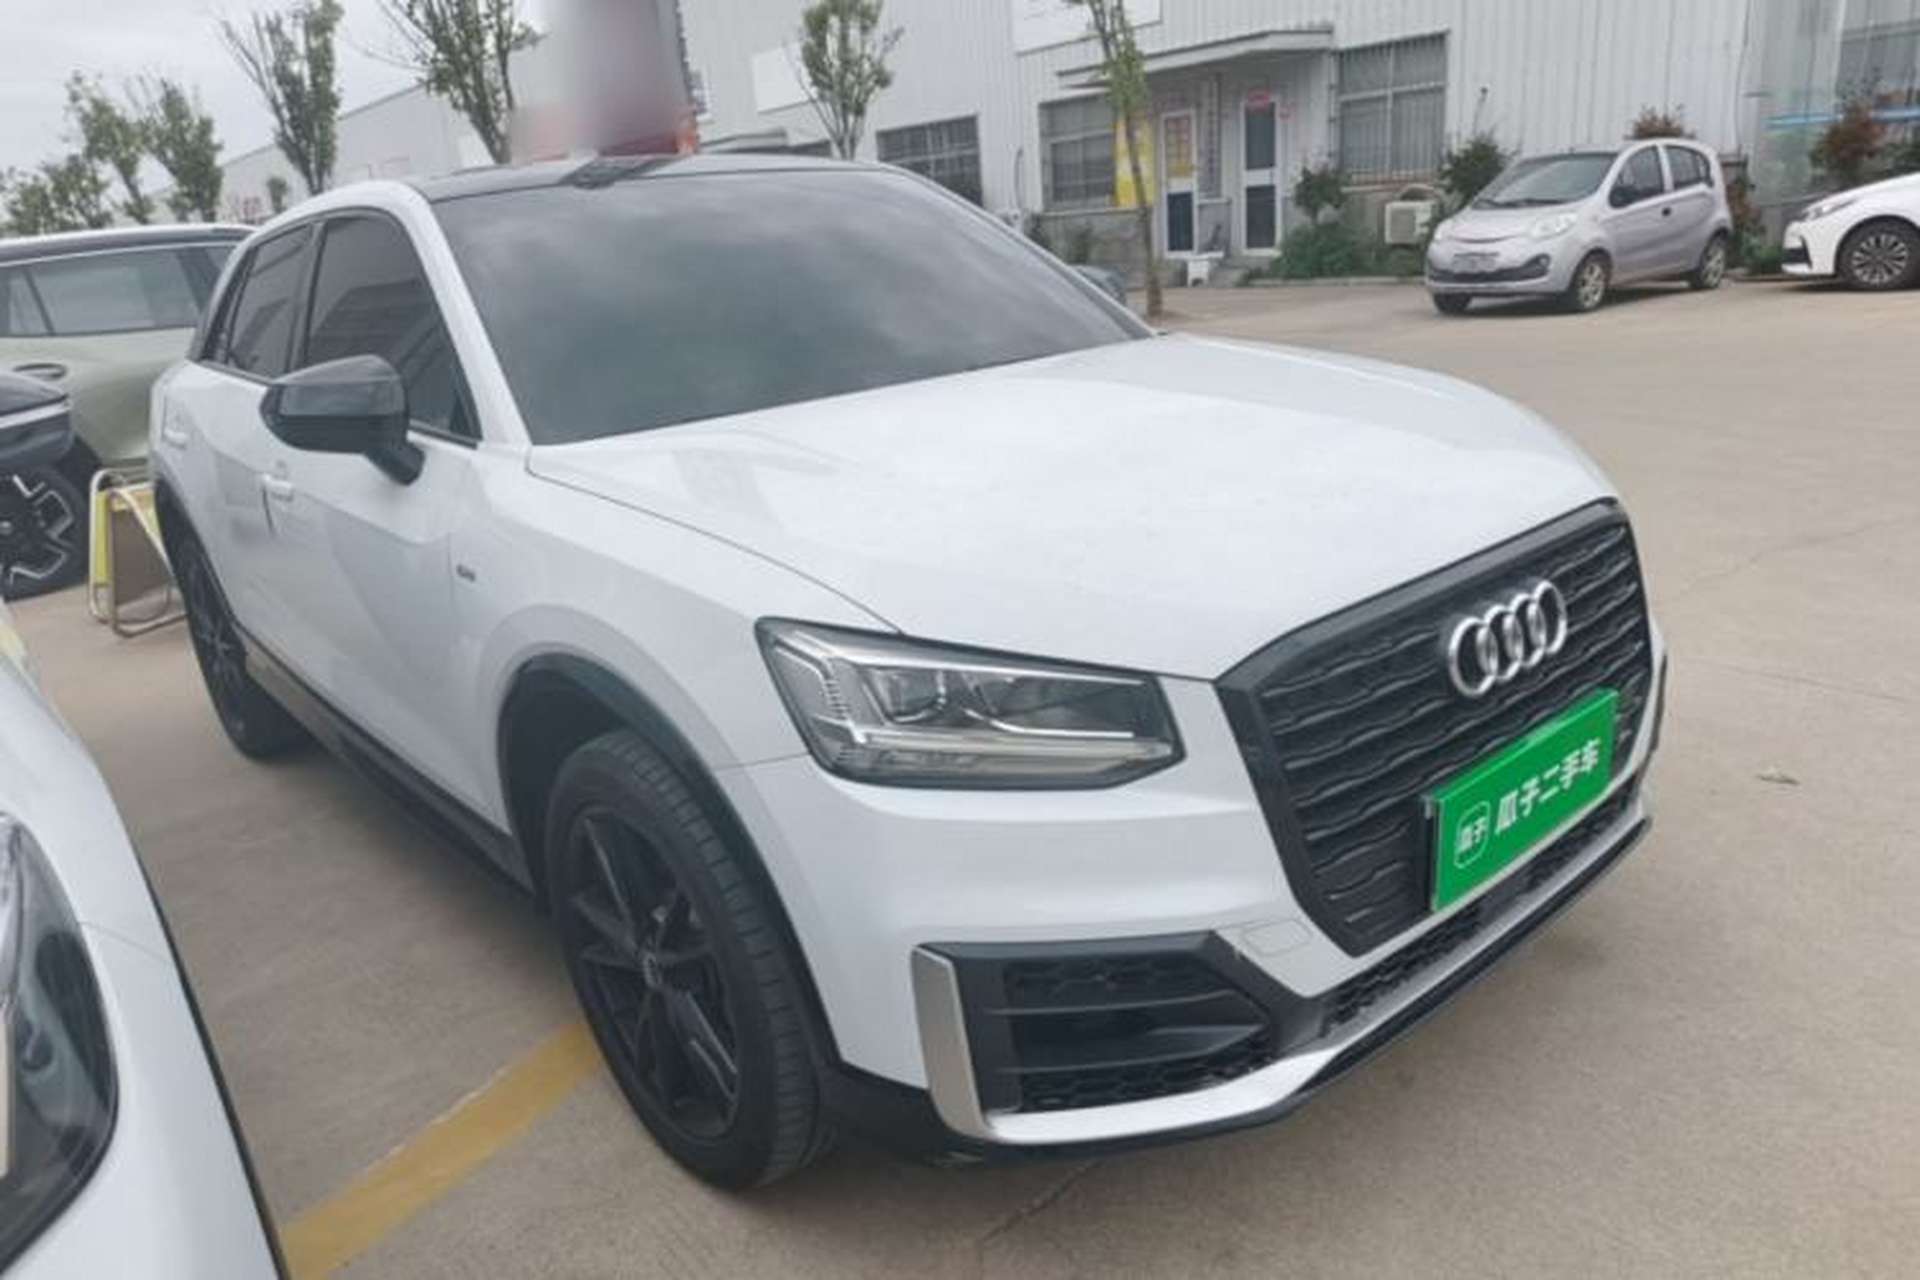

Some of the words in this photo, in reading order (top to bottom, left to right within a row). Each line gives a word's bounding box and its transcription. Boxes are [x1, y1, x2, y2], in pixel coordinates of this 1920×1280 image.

[1494, 737, 1601, 835] 瓜子二手车
